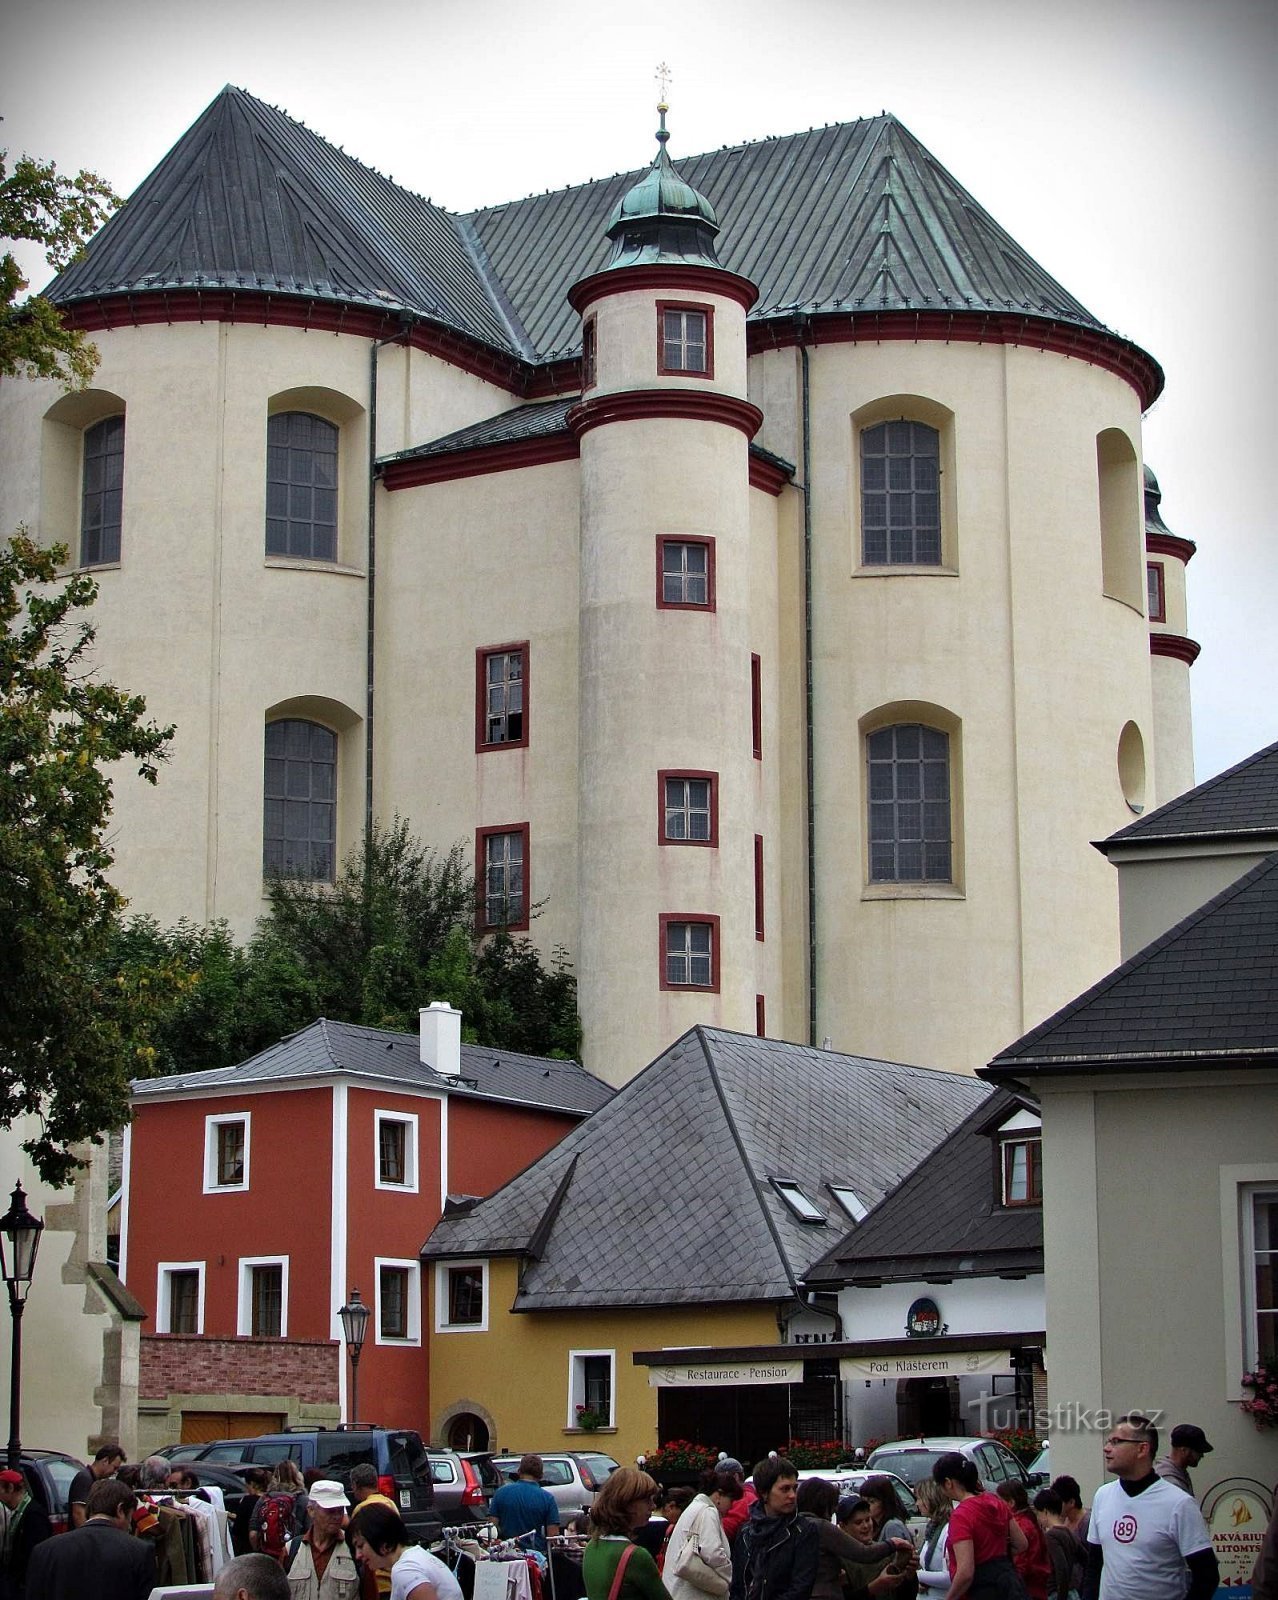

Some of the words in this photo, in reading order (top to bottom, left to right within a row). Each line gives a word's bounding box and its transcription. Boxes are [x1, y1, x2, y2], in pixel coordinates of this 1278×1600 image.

[870, 1362, 889, 1372] Pod
[896, 1359, 949, 1372] Klášterem
[687, 1369, 740, 1380] Restaurace
[749, 1366, 787, 1378] Pension
[1117, 1521, 1133, 1536] 89
[1216, 1542, 1261, 1552] LITOMYŠ
